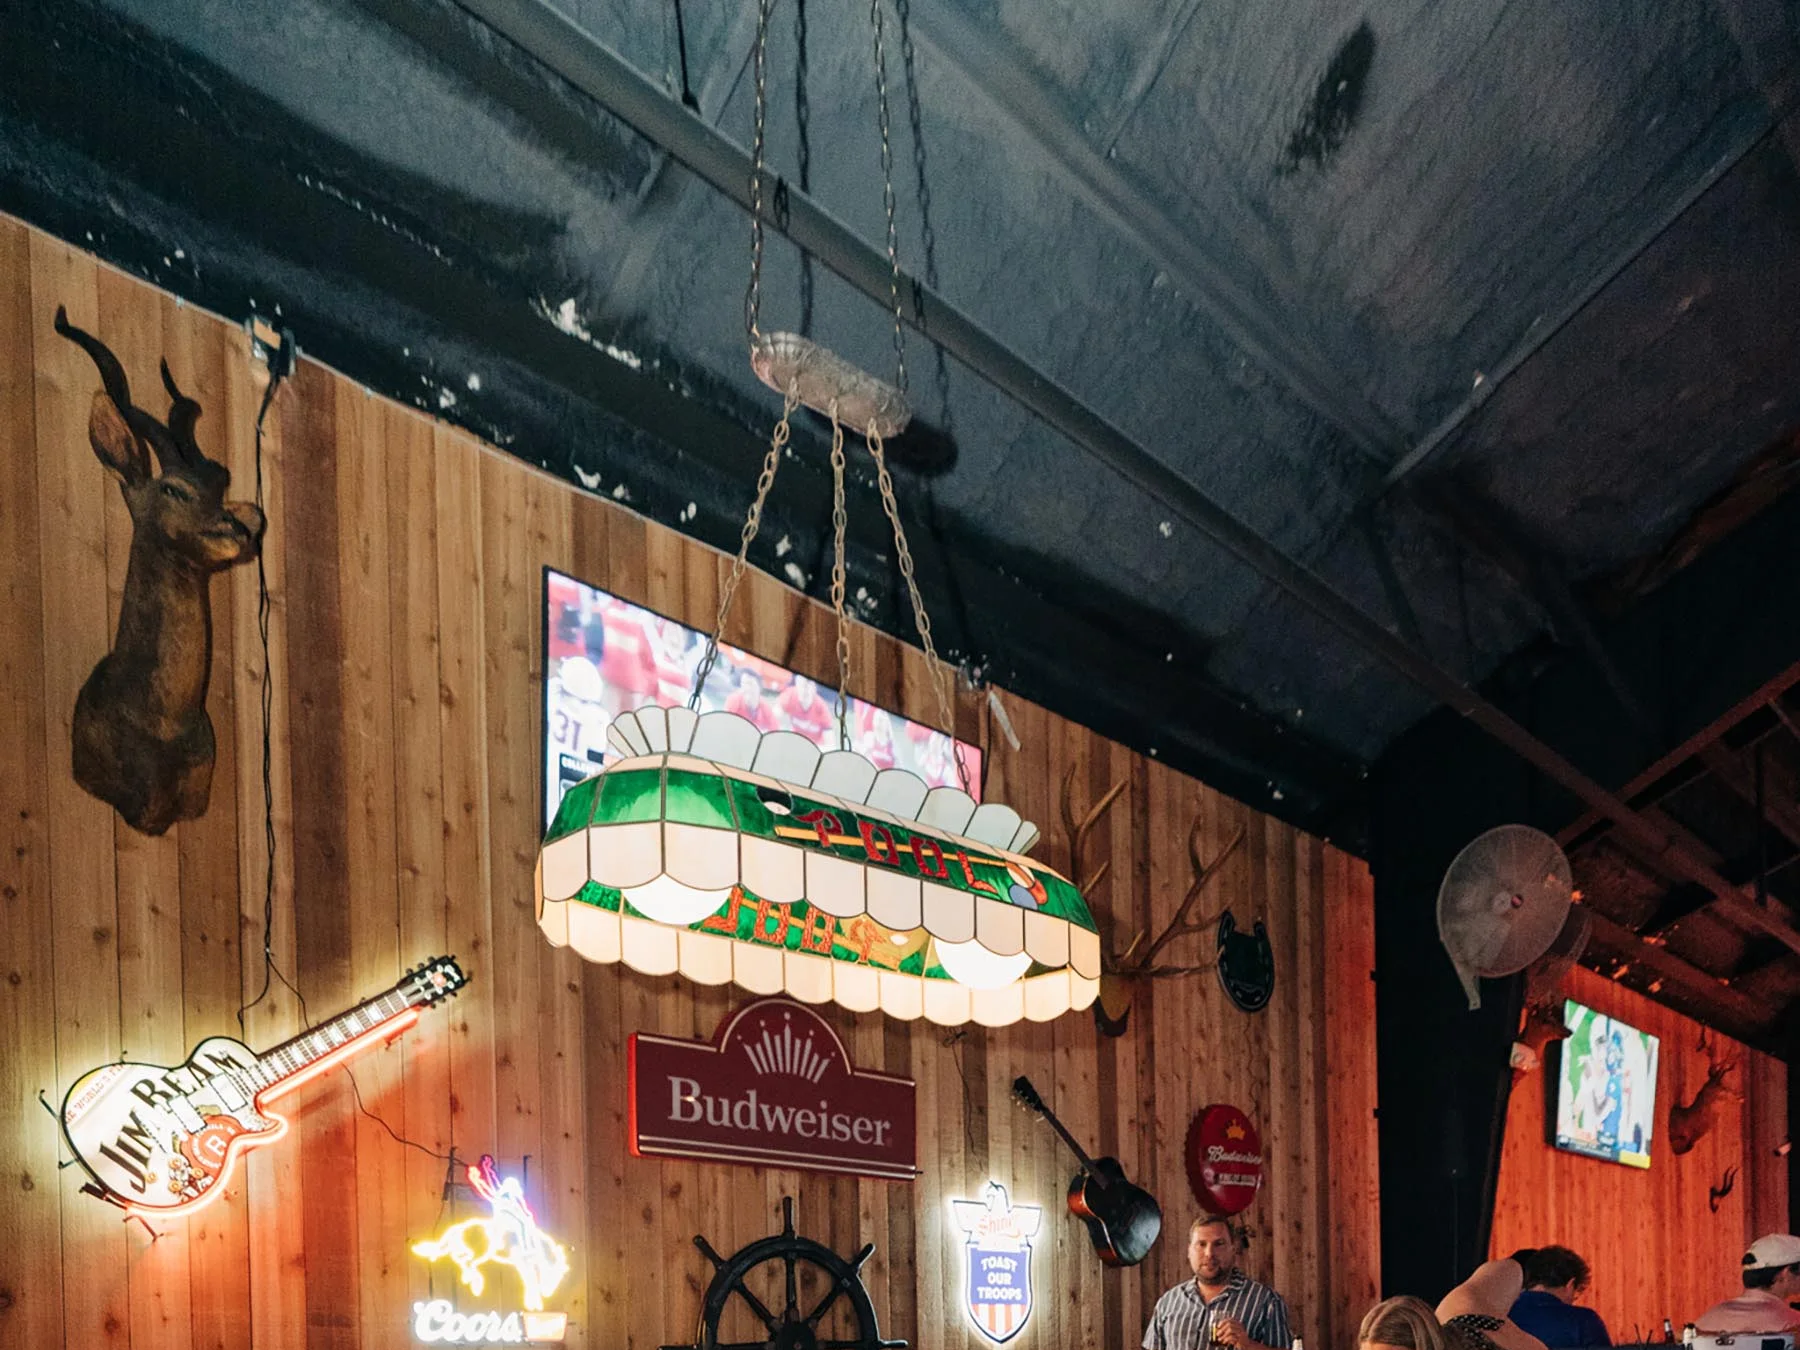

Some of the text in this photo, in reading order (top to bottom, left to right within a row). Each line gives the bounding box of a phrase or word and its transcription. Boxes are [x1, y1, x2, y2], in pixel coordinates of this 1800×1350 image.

[553, 708, 583, 751] 31
[796, 809, 998, 895] POOL
[98, 1107, 158, 1194] JIM
[130, 1050, 247, 1112] BEAM
[666, 1075, 892, 1147] Budweiser
[980, 1255, 1019, 1273] TOAST
[987, 1272, 1013, 1286] OUR
[976, 1286, 1023, 1301] TROOPS
[413, 1299, 523, 1343] Coors
